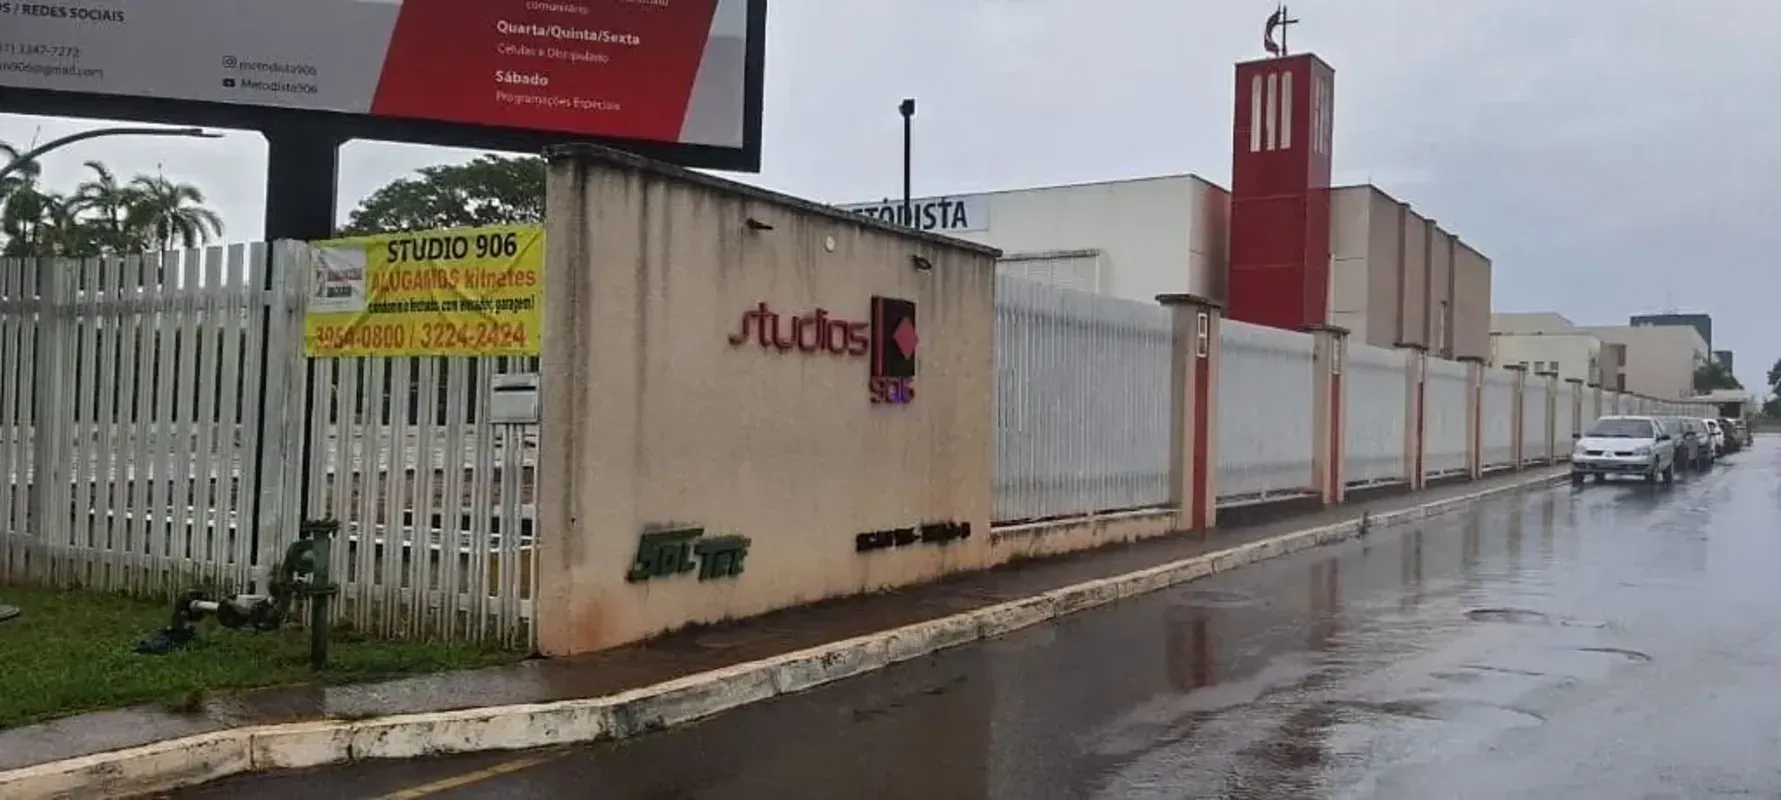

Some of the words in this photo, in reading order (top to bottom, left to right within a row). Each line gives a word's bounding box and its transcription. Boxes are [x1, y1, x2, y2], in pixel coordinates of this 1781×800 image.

[22, 4, 68, 18] REDES
[69, 8, 125, 22] SOCIAIS
[497, 20, 641, 46] Quarta/Quinta/Sexta
[496, 70, 548, 86] Sábado
[387, 236, 468, 263] STUDIO
[476, 233, 518, 259] 906
[371, 269, 459, 294] ALUGAMOS
[729, 302, 870, 356] studios
